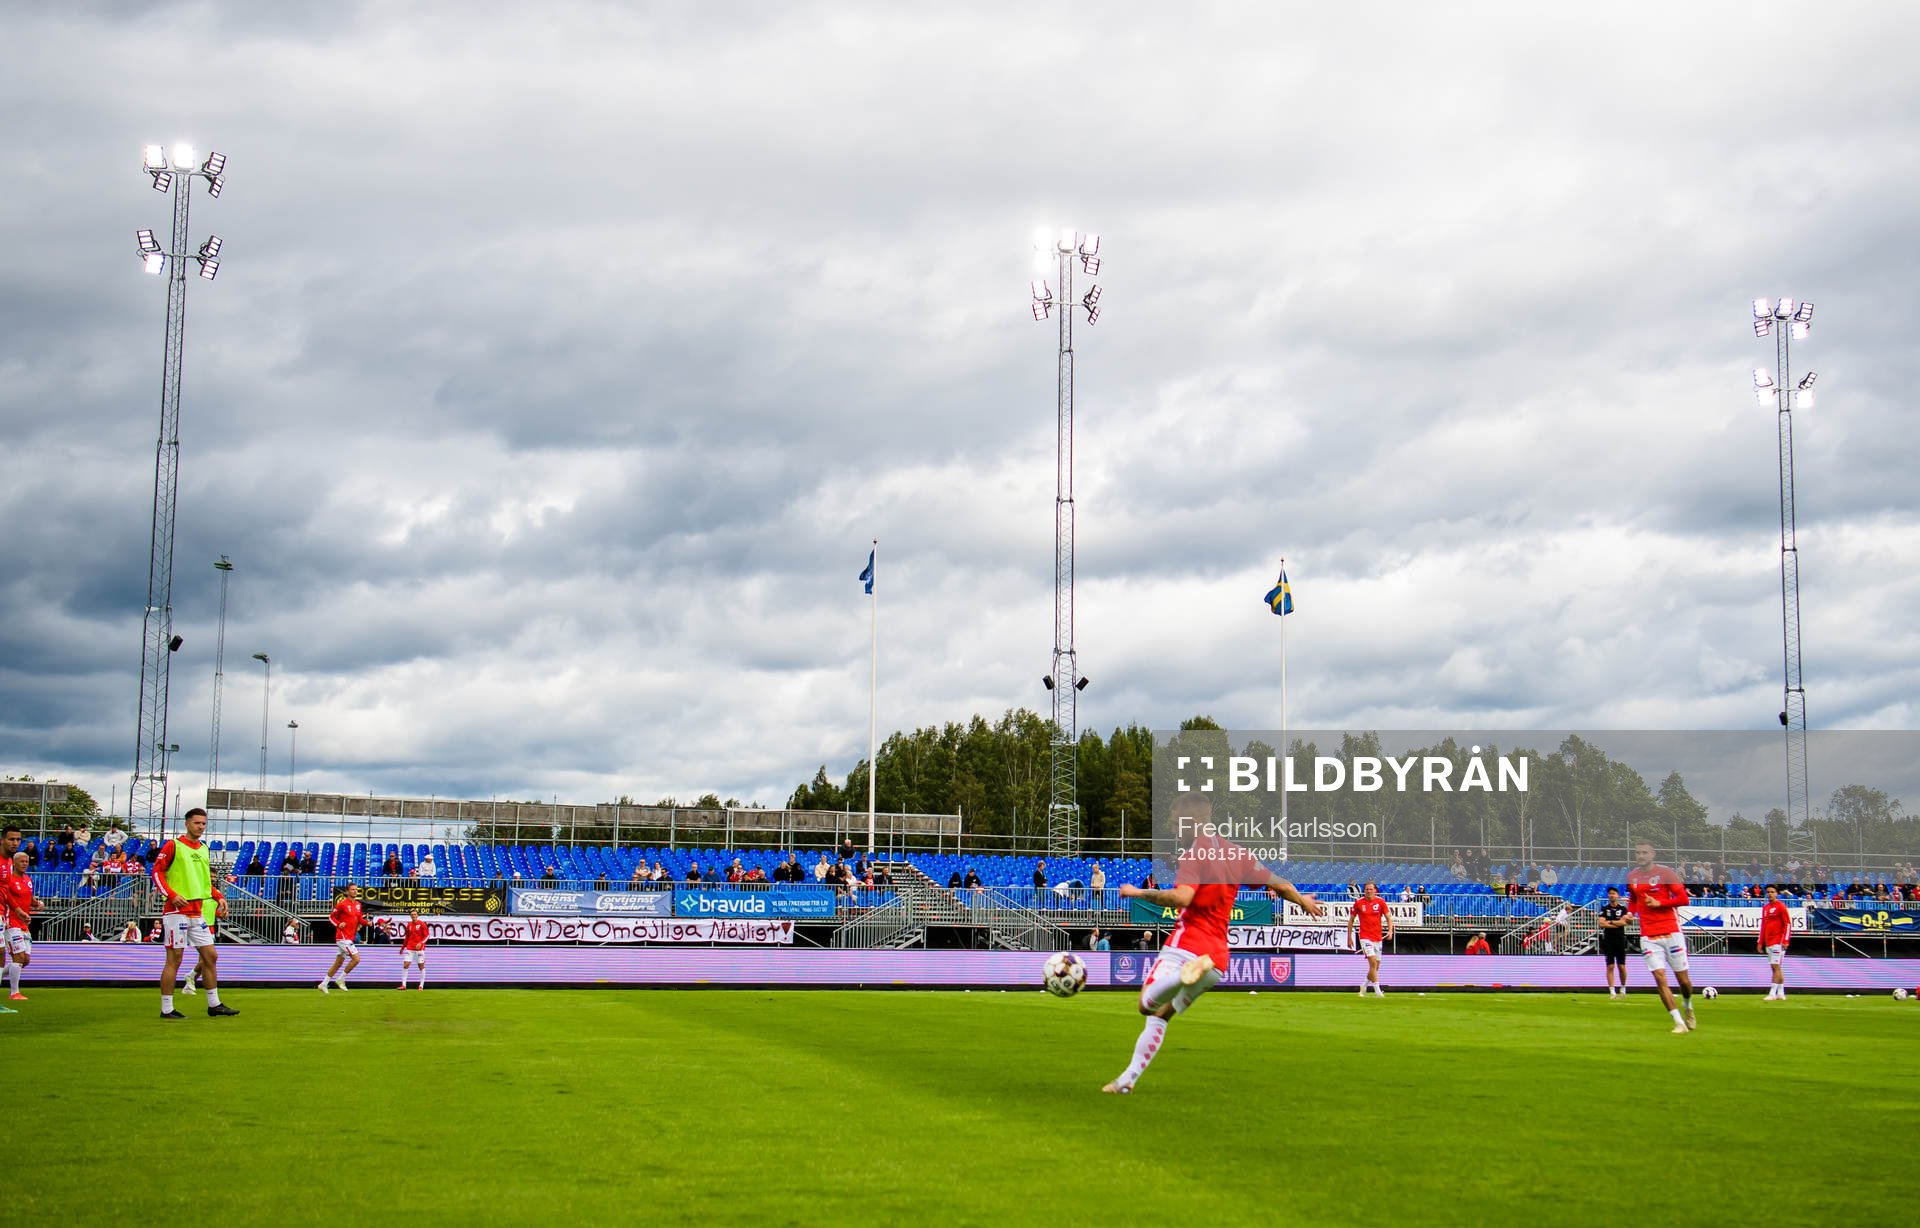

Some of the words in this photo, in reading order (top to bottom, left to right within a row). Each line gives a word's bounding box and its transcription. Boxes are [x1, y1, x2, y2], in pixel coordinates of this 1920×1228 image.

[700, 895, 765, 913] bravida
[487, 918, 524, 939] Gör
[528, 918, 542, 939] Vi
[546, 919, 590, 939] Det
[592, 919, 702, 940] Omöjliga
[1228, 926, 1266, 945] STÅ
[1271, 928, 1302, 946] UPP
